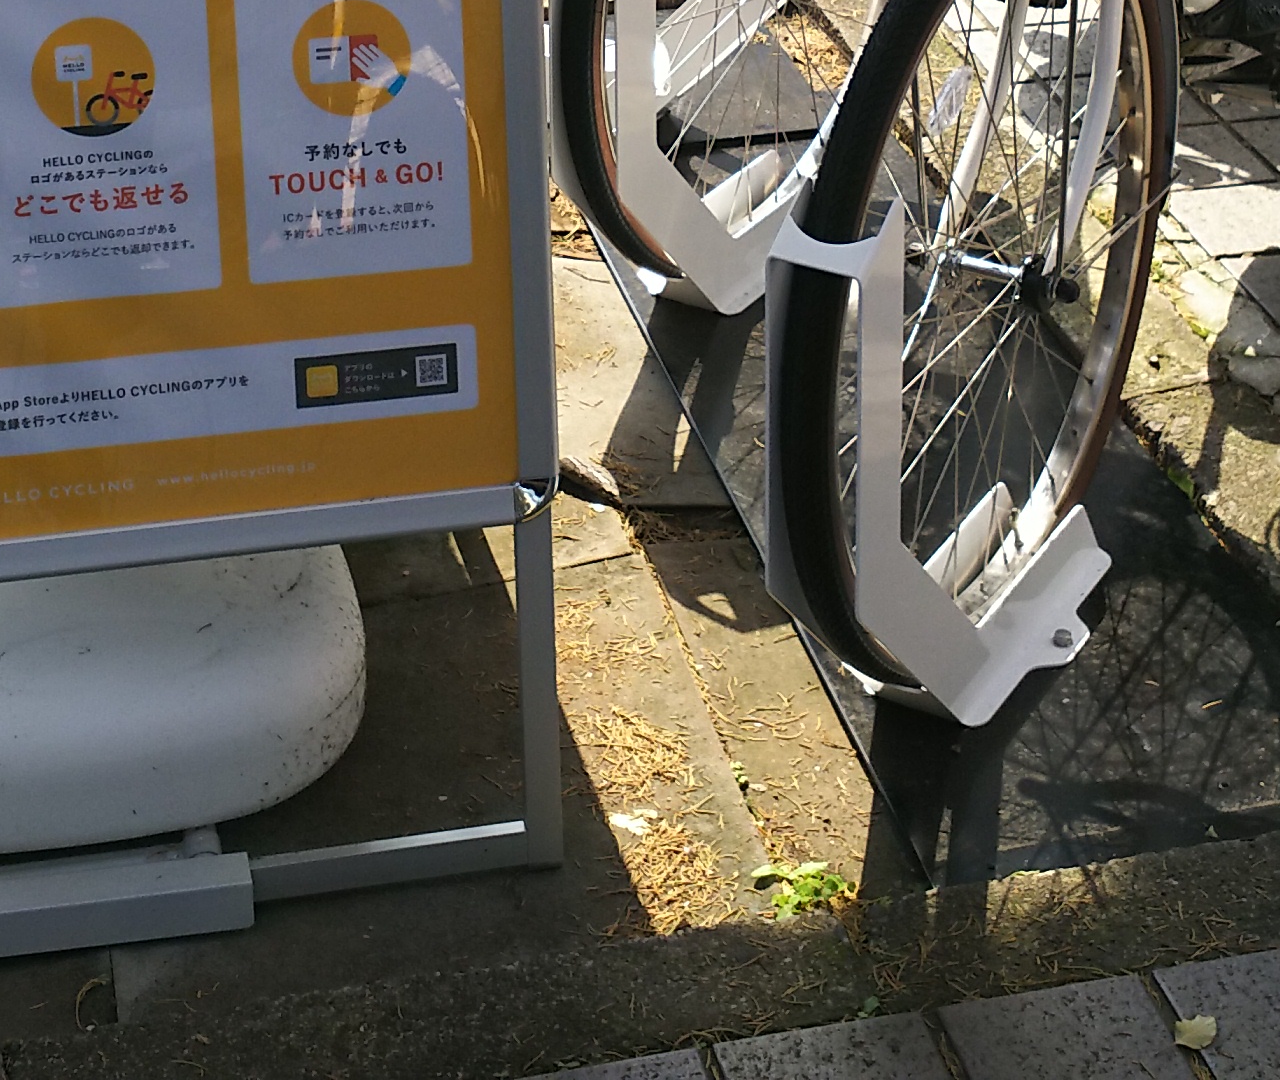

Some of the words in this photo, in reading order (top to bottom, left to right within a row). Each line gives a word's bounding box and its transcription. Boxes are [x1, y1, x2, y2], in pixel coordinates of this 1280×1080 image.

[42, 154, 84, 168] HELLO
[87, 149, 154, 164] CYCLINGの
[304, 138, 407, 162] 予約なしでも
[30, 163, 169, 184] ロゴがあるステーションなら
[269, 168, 366, 195] TOUCH
[375, 168, 389, 184] &
[395, 161, 443, 185] GO!
[14, 182, 189, 217] どこでも返せる
[29, 233, 65, 245] HELLO
[49, 479, 134, 499] CYCLING
[157, 461, 316, 487] www.hellocycling.jp
